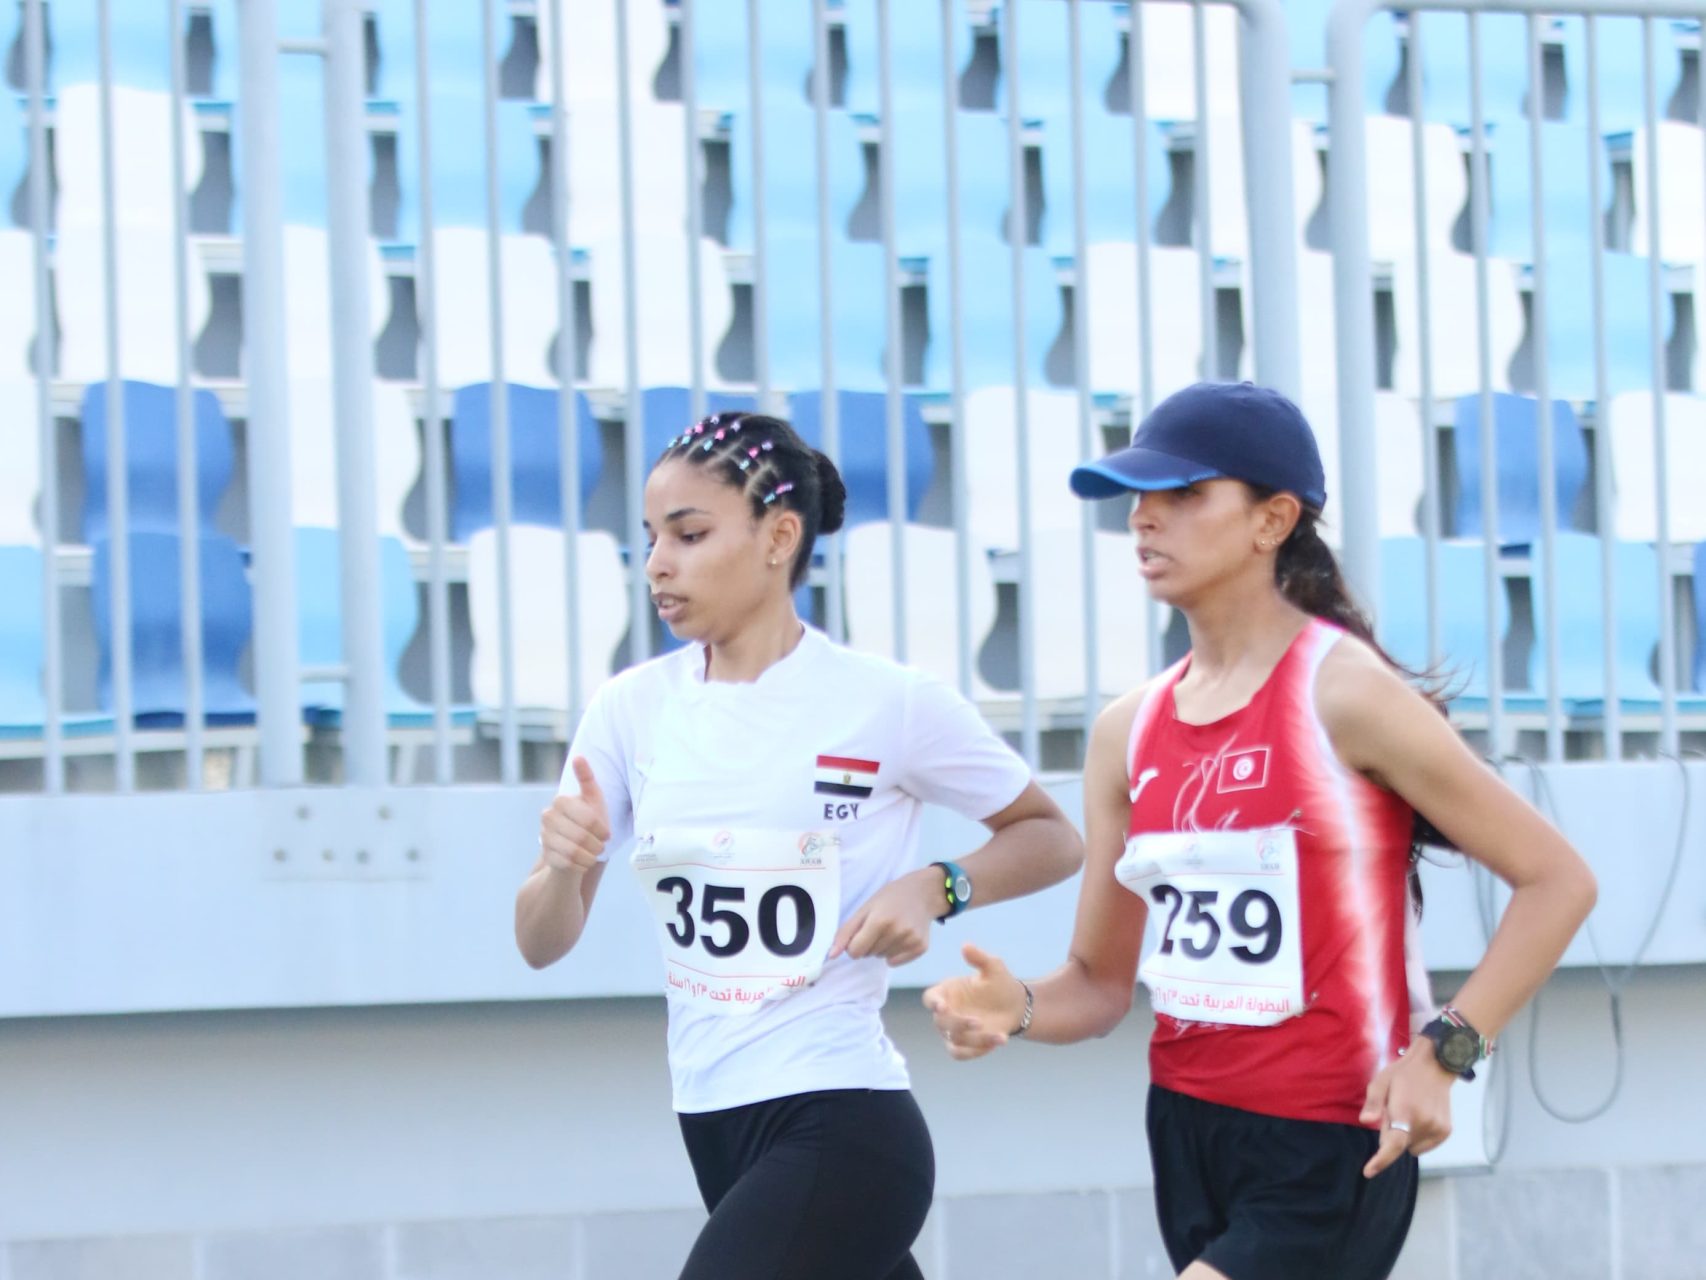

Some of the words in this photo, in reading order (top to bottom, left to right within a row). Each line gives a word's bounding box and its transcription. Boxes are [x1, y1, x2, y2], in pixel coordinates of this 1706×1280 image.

[823, 803, 860, 821] EGY
[656, 876, 816, 959] 350
[1150, 884, 1283, 965] 259
